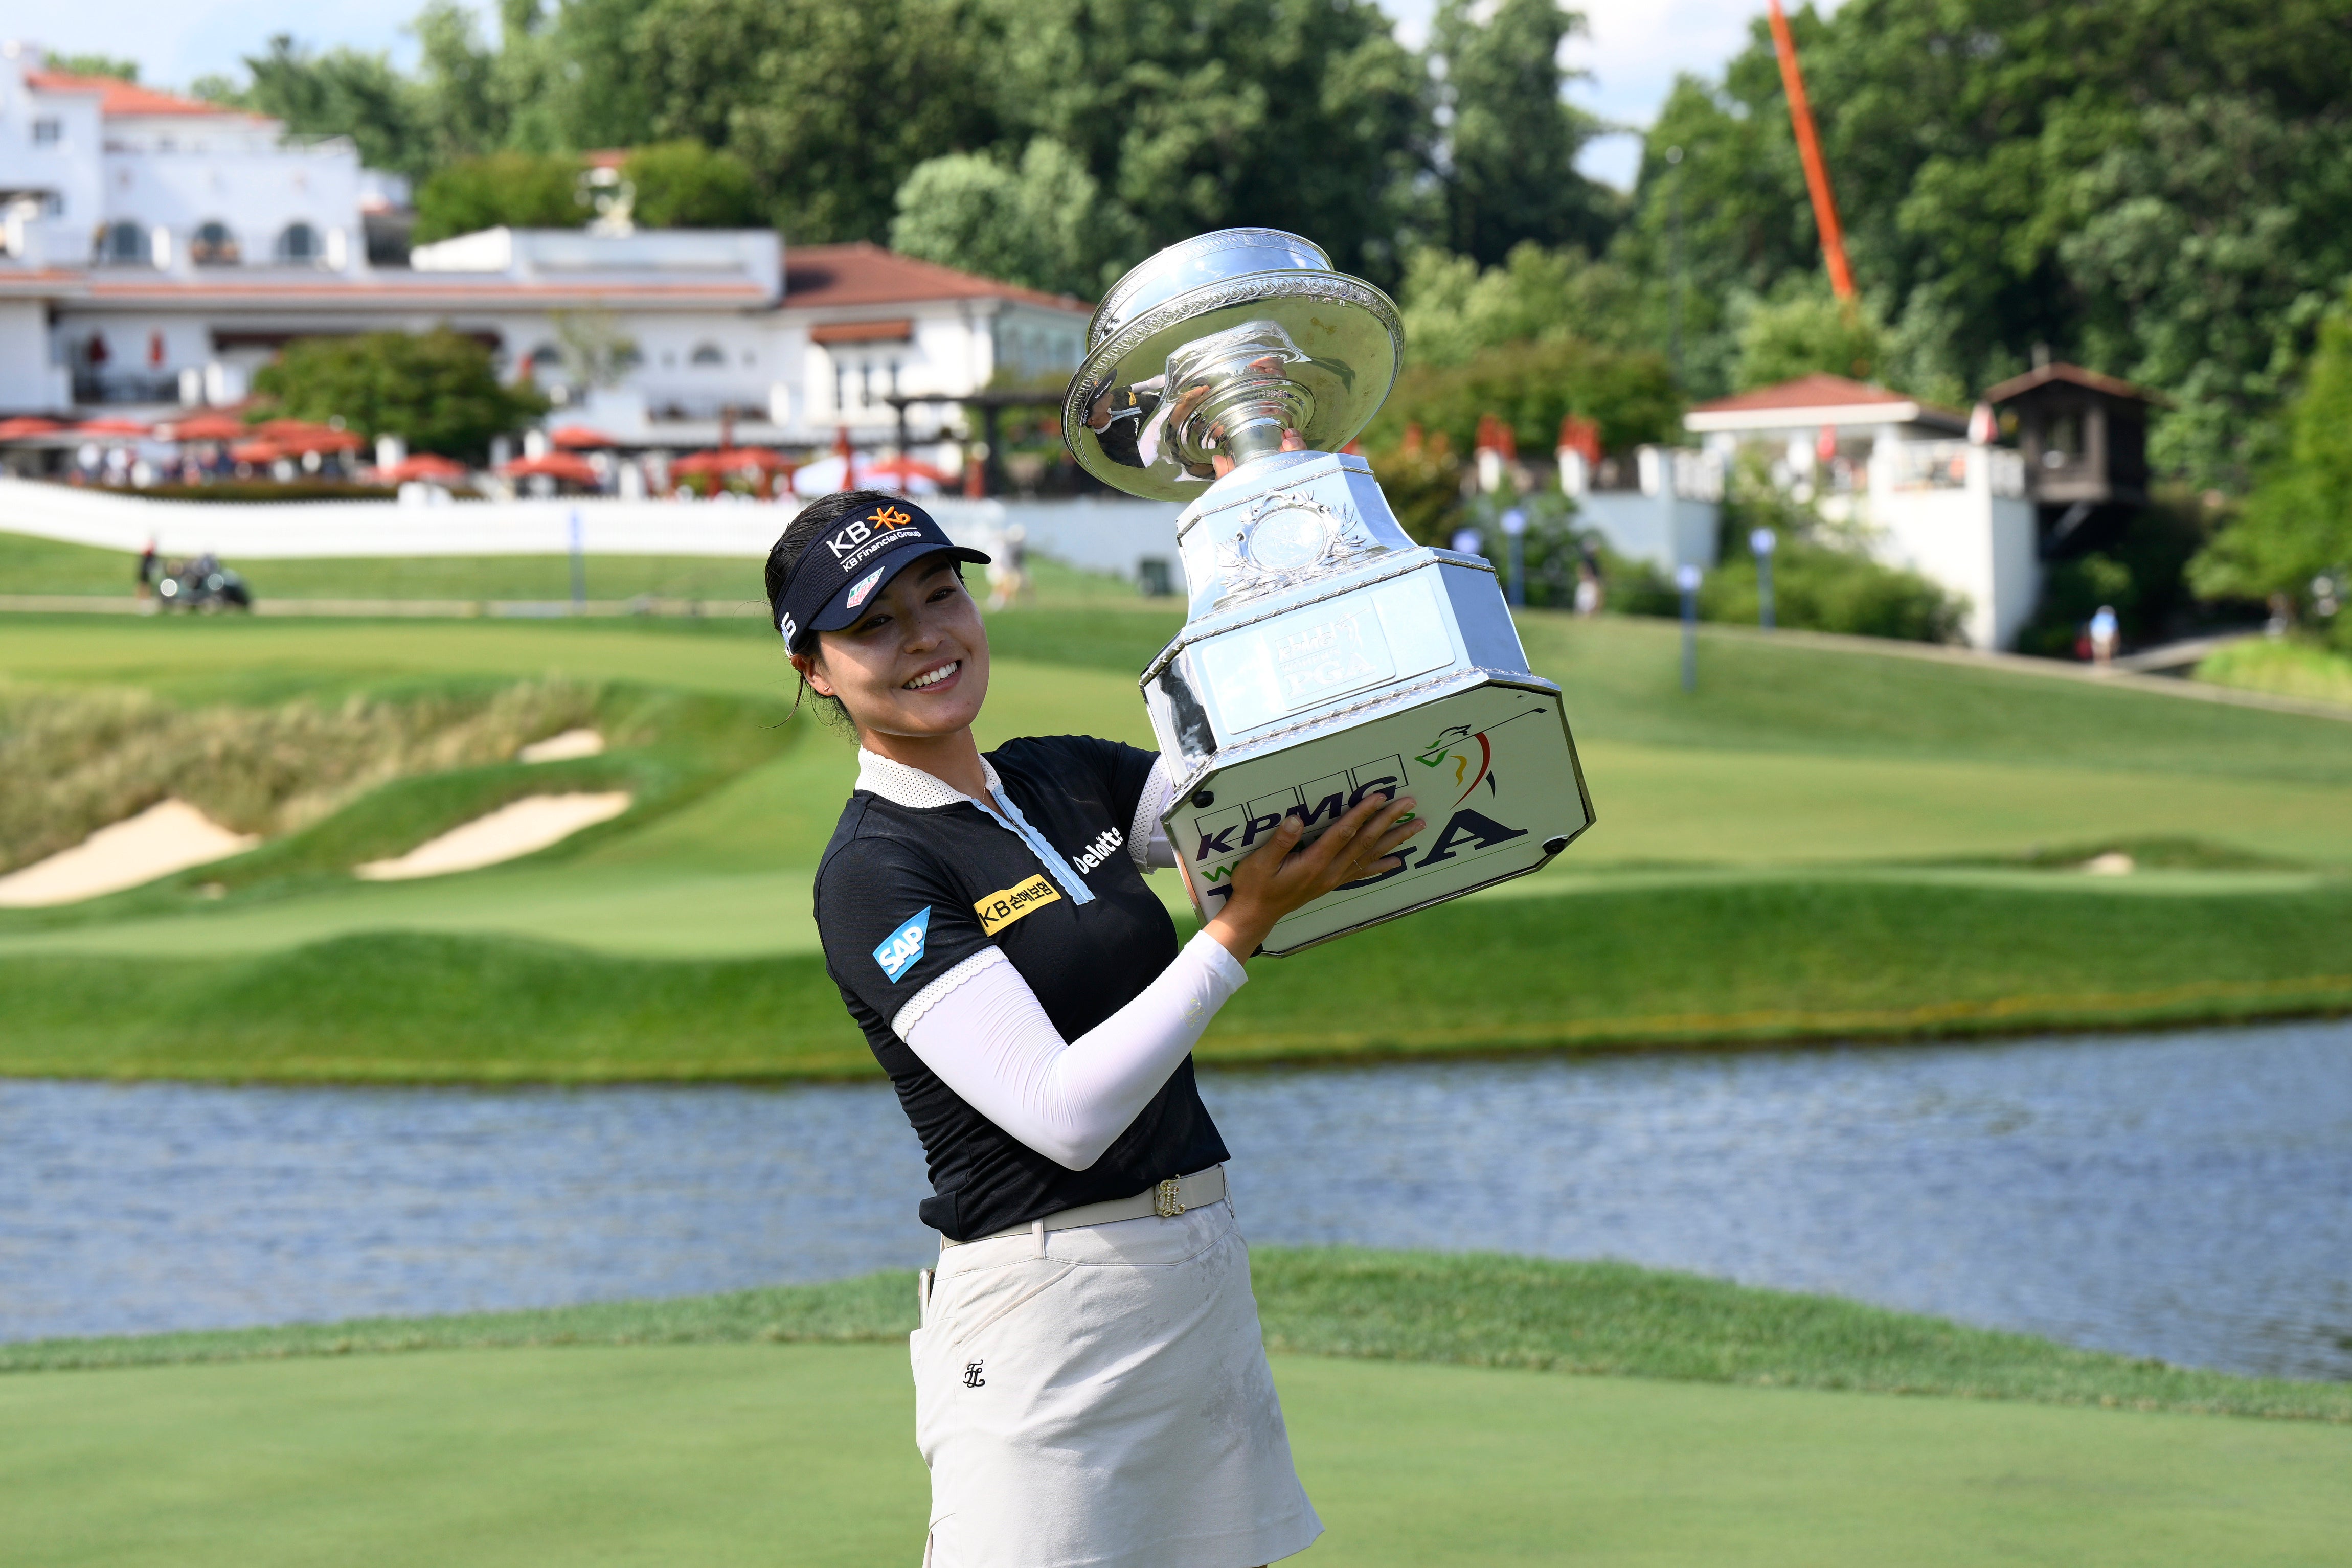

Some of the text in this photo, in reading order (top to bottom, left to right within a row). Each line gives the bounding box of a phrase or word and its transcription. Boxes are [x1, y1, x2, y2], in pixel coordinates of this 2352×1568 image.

[826, 521, 871, 559] KB
[843, 557, 858, 572] KB
[856, 531, 898, 561] Financial
[1278, 632, 1333, 662] KPMG
[1283, 652, 1376, 697] PGA
[1196, 776, 1398, 861] KPMG
[1072, 827, 1123, 875] Deloitte
[979, 881, 1053, 928] KB손해보험
[879, 926, 923, 975] SAP
